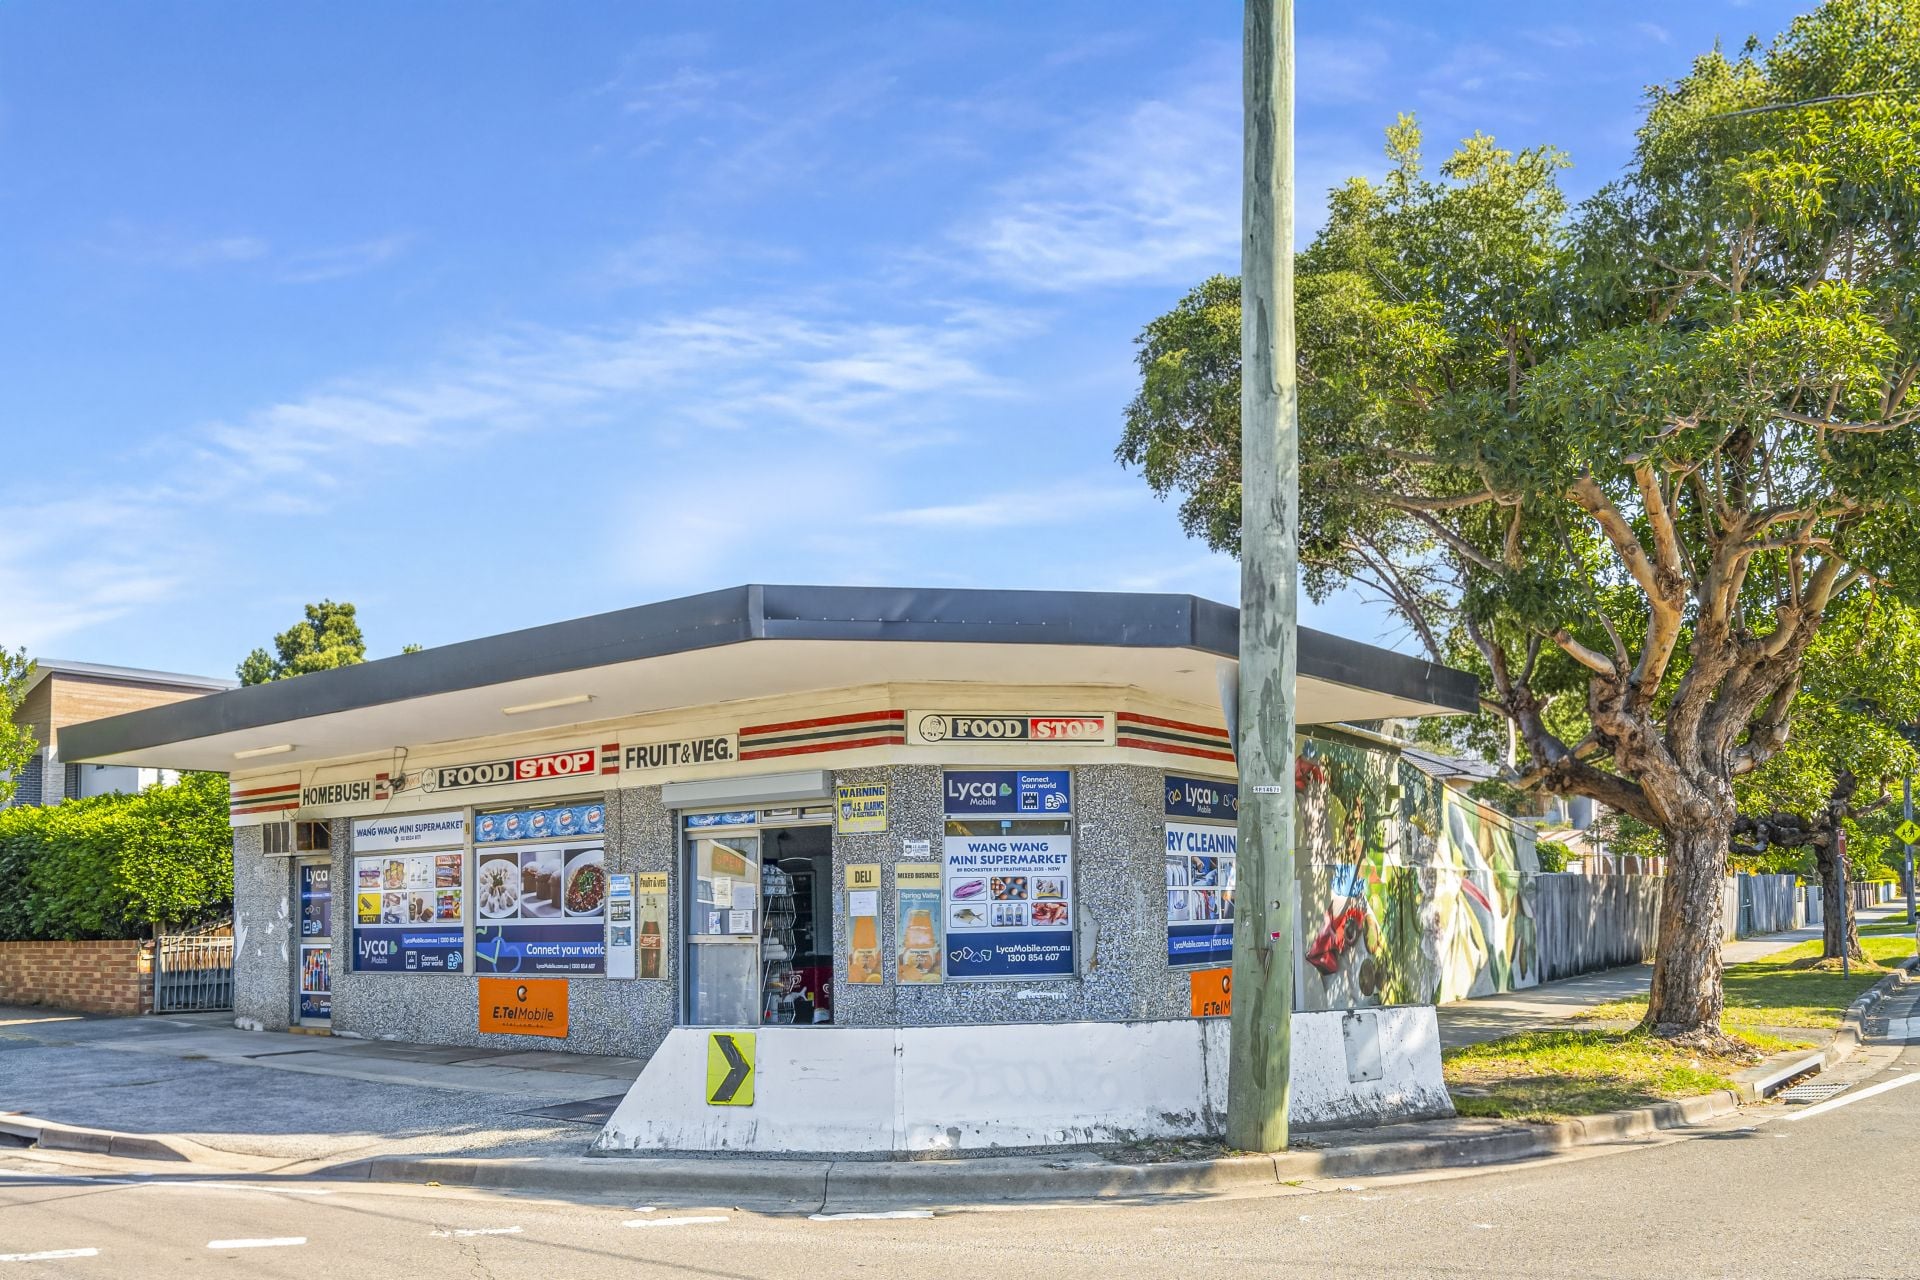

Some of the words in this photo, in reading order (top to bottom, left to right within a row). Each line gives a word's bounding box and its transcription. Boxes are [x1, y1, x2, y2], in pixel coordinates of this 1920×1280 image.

[956, 720, 1022, 738] FOOD
[1036, 721, 1099, 738] STOP
[442, 763, 510, 787] FOOD
[519, 753, 590, 779] STOP
[302, 781, 370, 806] HOMEBUSH
[839, 787, 885, 798] WARNING
[948, 779, 997, 800] Lyca
[1186, 783, 1211, 807] Lyca
[864, 801, 885, 811] ALARMS
[969, 798, 997, 806] Mobile
[1197, 805, 1212, 814] Mobile
[356, 828, 376, 837] WANG
[376, 826, 398, 836] WANG
[398, 824, 414, 834] MINI
[414, 820, 464, 833] SUPERMARKET
[968, 843, 1007, 852] WANG
[1010, 842, 1049, 852] WANG
[1166, 831, 1184, 852] RY
[950, 856, 977, 865] MINI
[980, 854, 1068, 864] SUPERMARKET
[306, 868, 328, 884] Lyca
[854, 870, 872, 884] DELI
[901, 892, 921, 900] Spring
[922, 892, 940, 900] Valley
[358, 937, 388, 959] Lyca
[526, 943, 560, 955] Connect
[561, 946, 580, 958] your
[996, 944, 1070, 954] LycaMobile.com.au
[1174, 940, 1210, 950] LycaMobile.com.au
[371, 956, 388, 964] Mobile
[1007, 954, 1026, 962] 1300
[1045, 953, 1060, 961] 607
